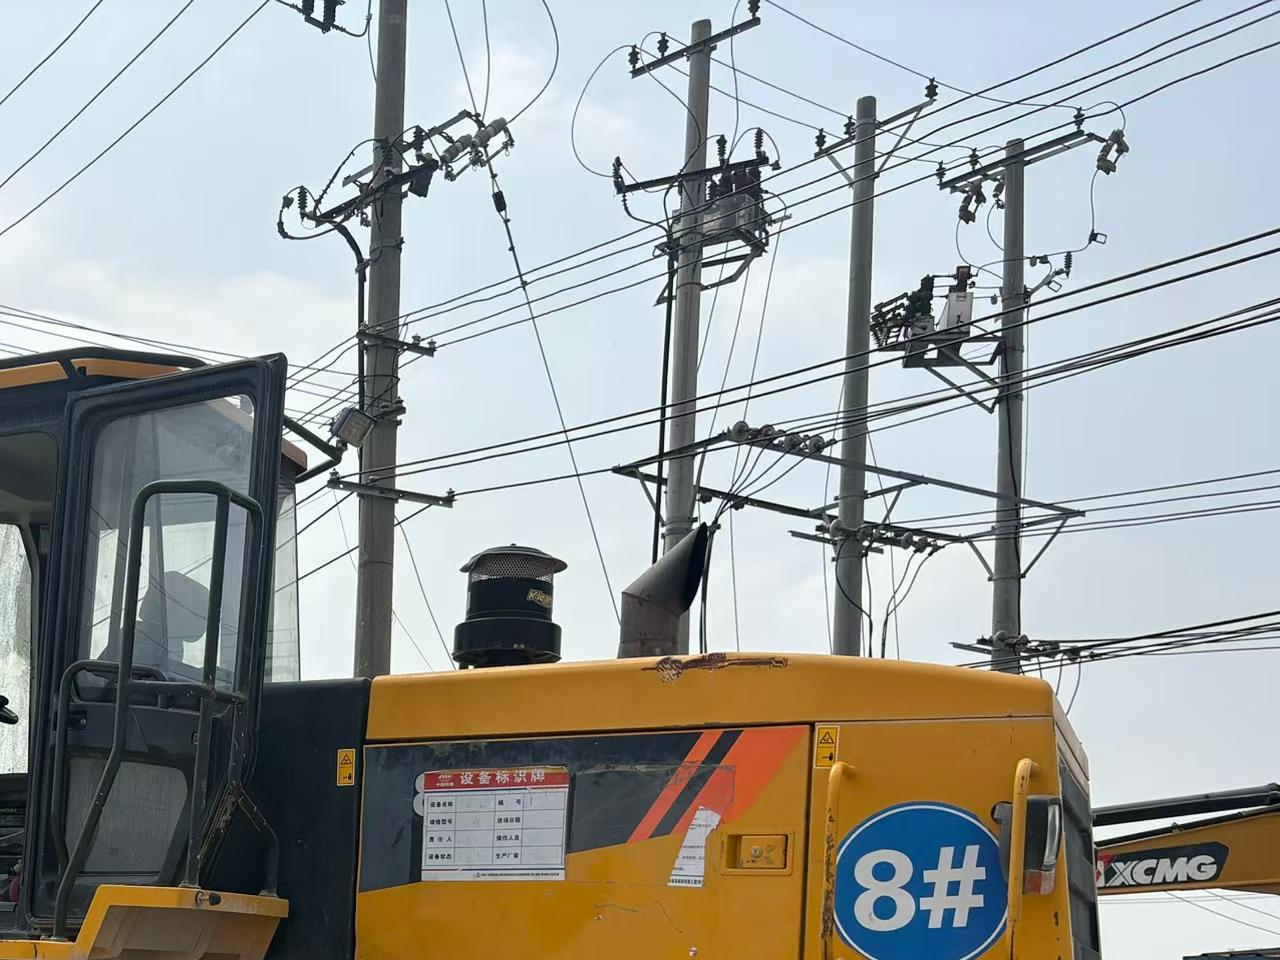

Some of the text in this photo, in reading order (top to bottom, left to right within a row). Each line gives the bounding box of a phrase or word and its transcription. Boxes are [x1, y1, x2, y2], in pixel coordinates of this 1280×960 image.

[460, 768, 545, 785] 设备标识牌
[1106, 855, 1217, 887] XCMG
[854, 845, 986, 931] 8#
